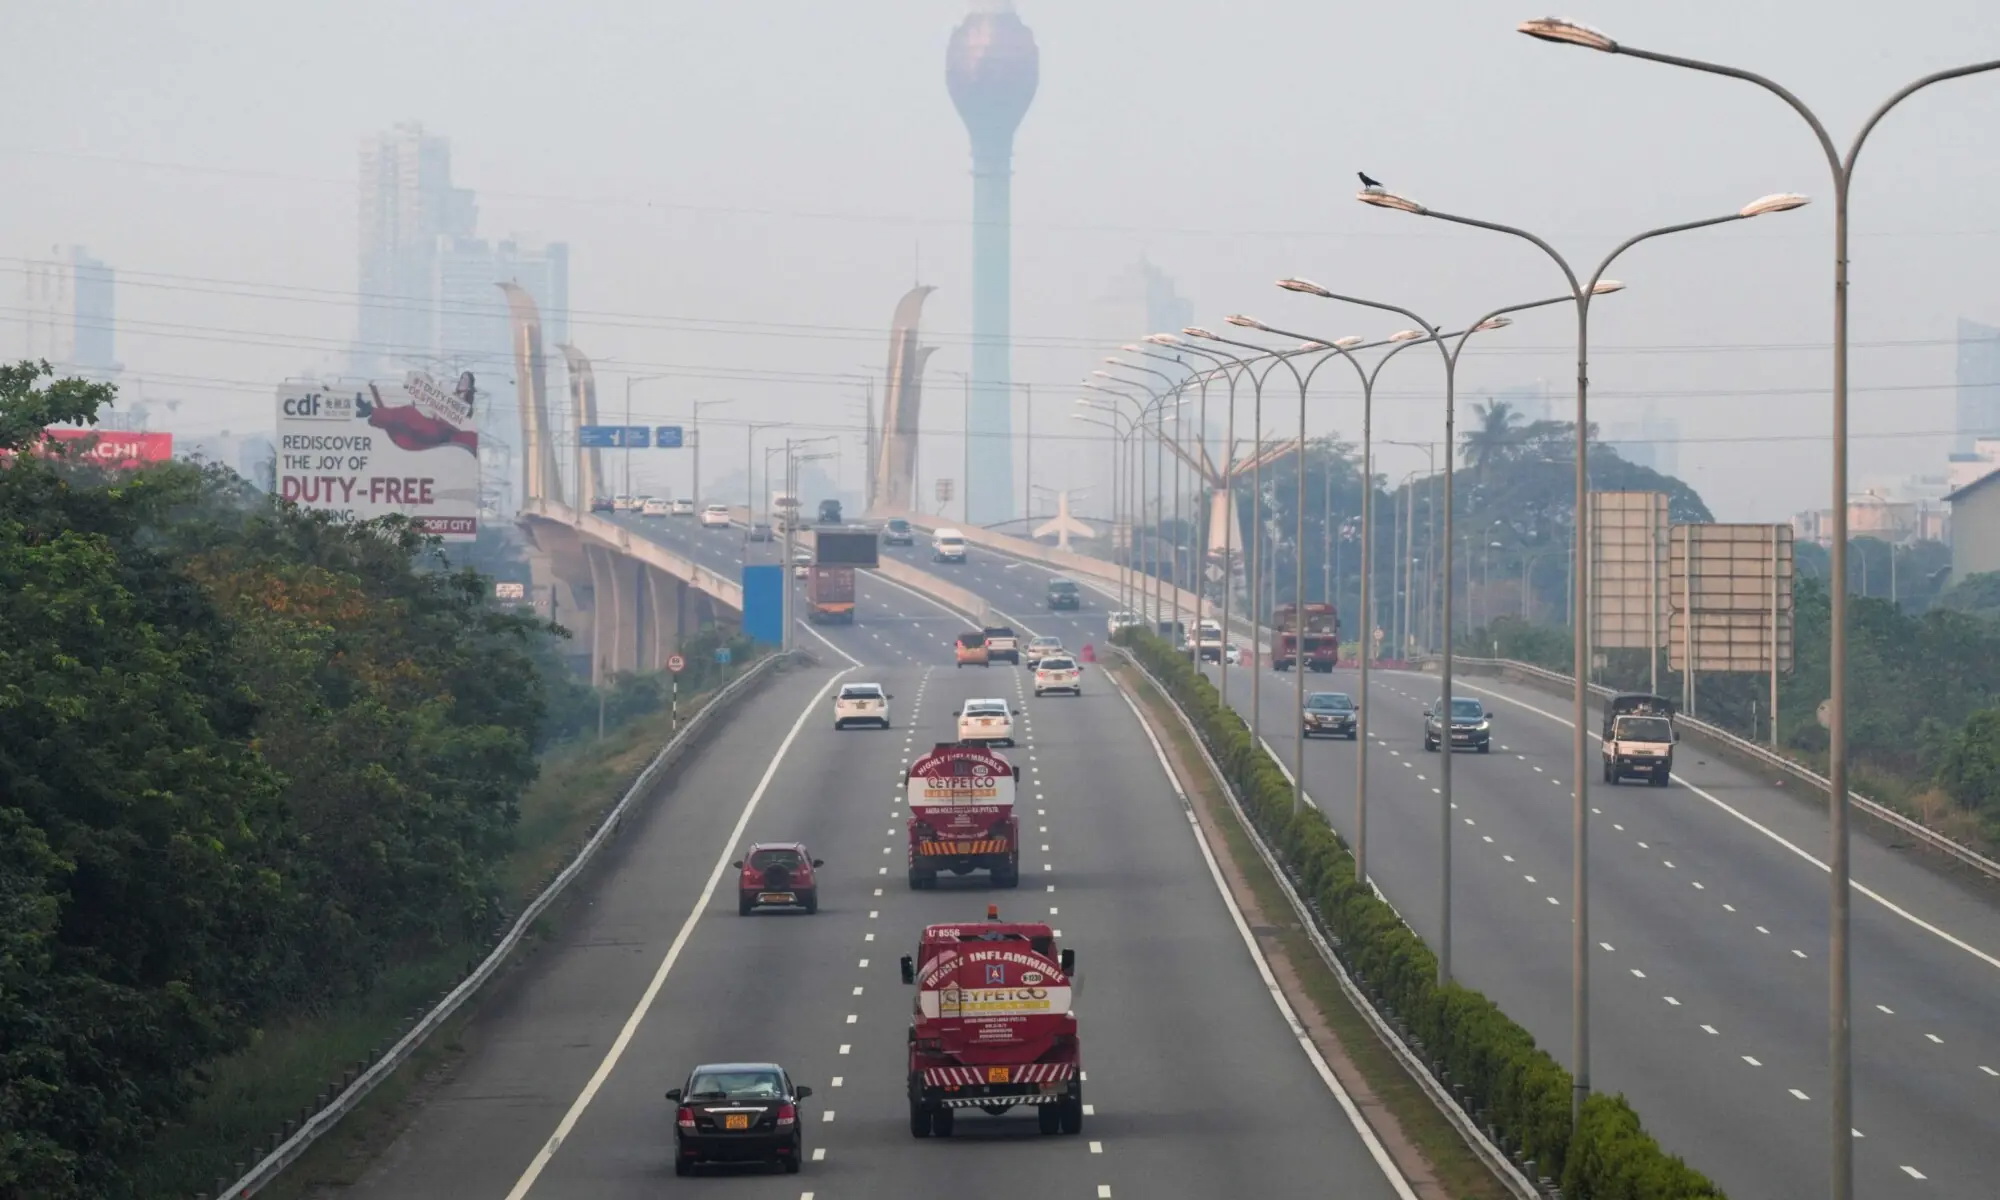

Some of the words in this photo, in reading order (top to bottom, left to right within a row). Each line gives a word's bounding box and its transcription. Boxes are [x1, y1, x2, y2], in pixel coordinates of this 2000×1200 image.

[283, 394, 321, 416] cdf
[408, 385, 463, 424] DESTINATION
[424, 383, 446, 400] DUTY
[446, 396, 465, 417] FREE
[283, 435, 372, 450] REDISCOVER
[284, 455, 311, 469] THE
[316, 456, 343, 470] JOY
[348, 456, 368, 470] OF
[282, 476, 434, 504] DUTY-FREE
[423, 519, 448, 530] PORT
[451, 519, 472, 531] CITY
[917, 755, 945, 775] HIGHLY
[969, 950, 1064, 983] INFLAMMABLE
[991, 969, 999, 978] A
[943, 988, 1048, 1002] CEYPETCO
